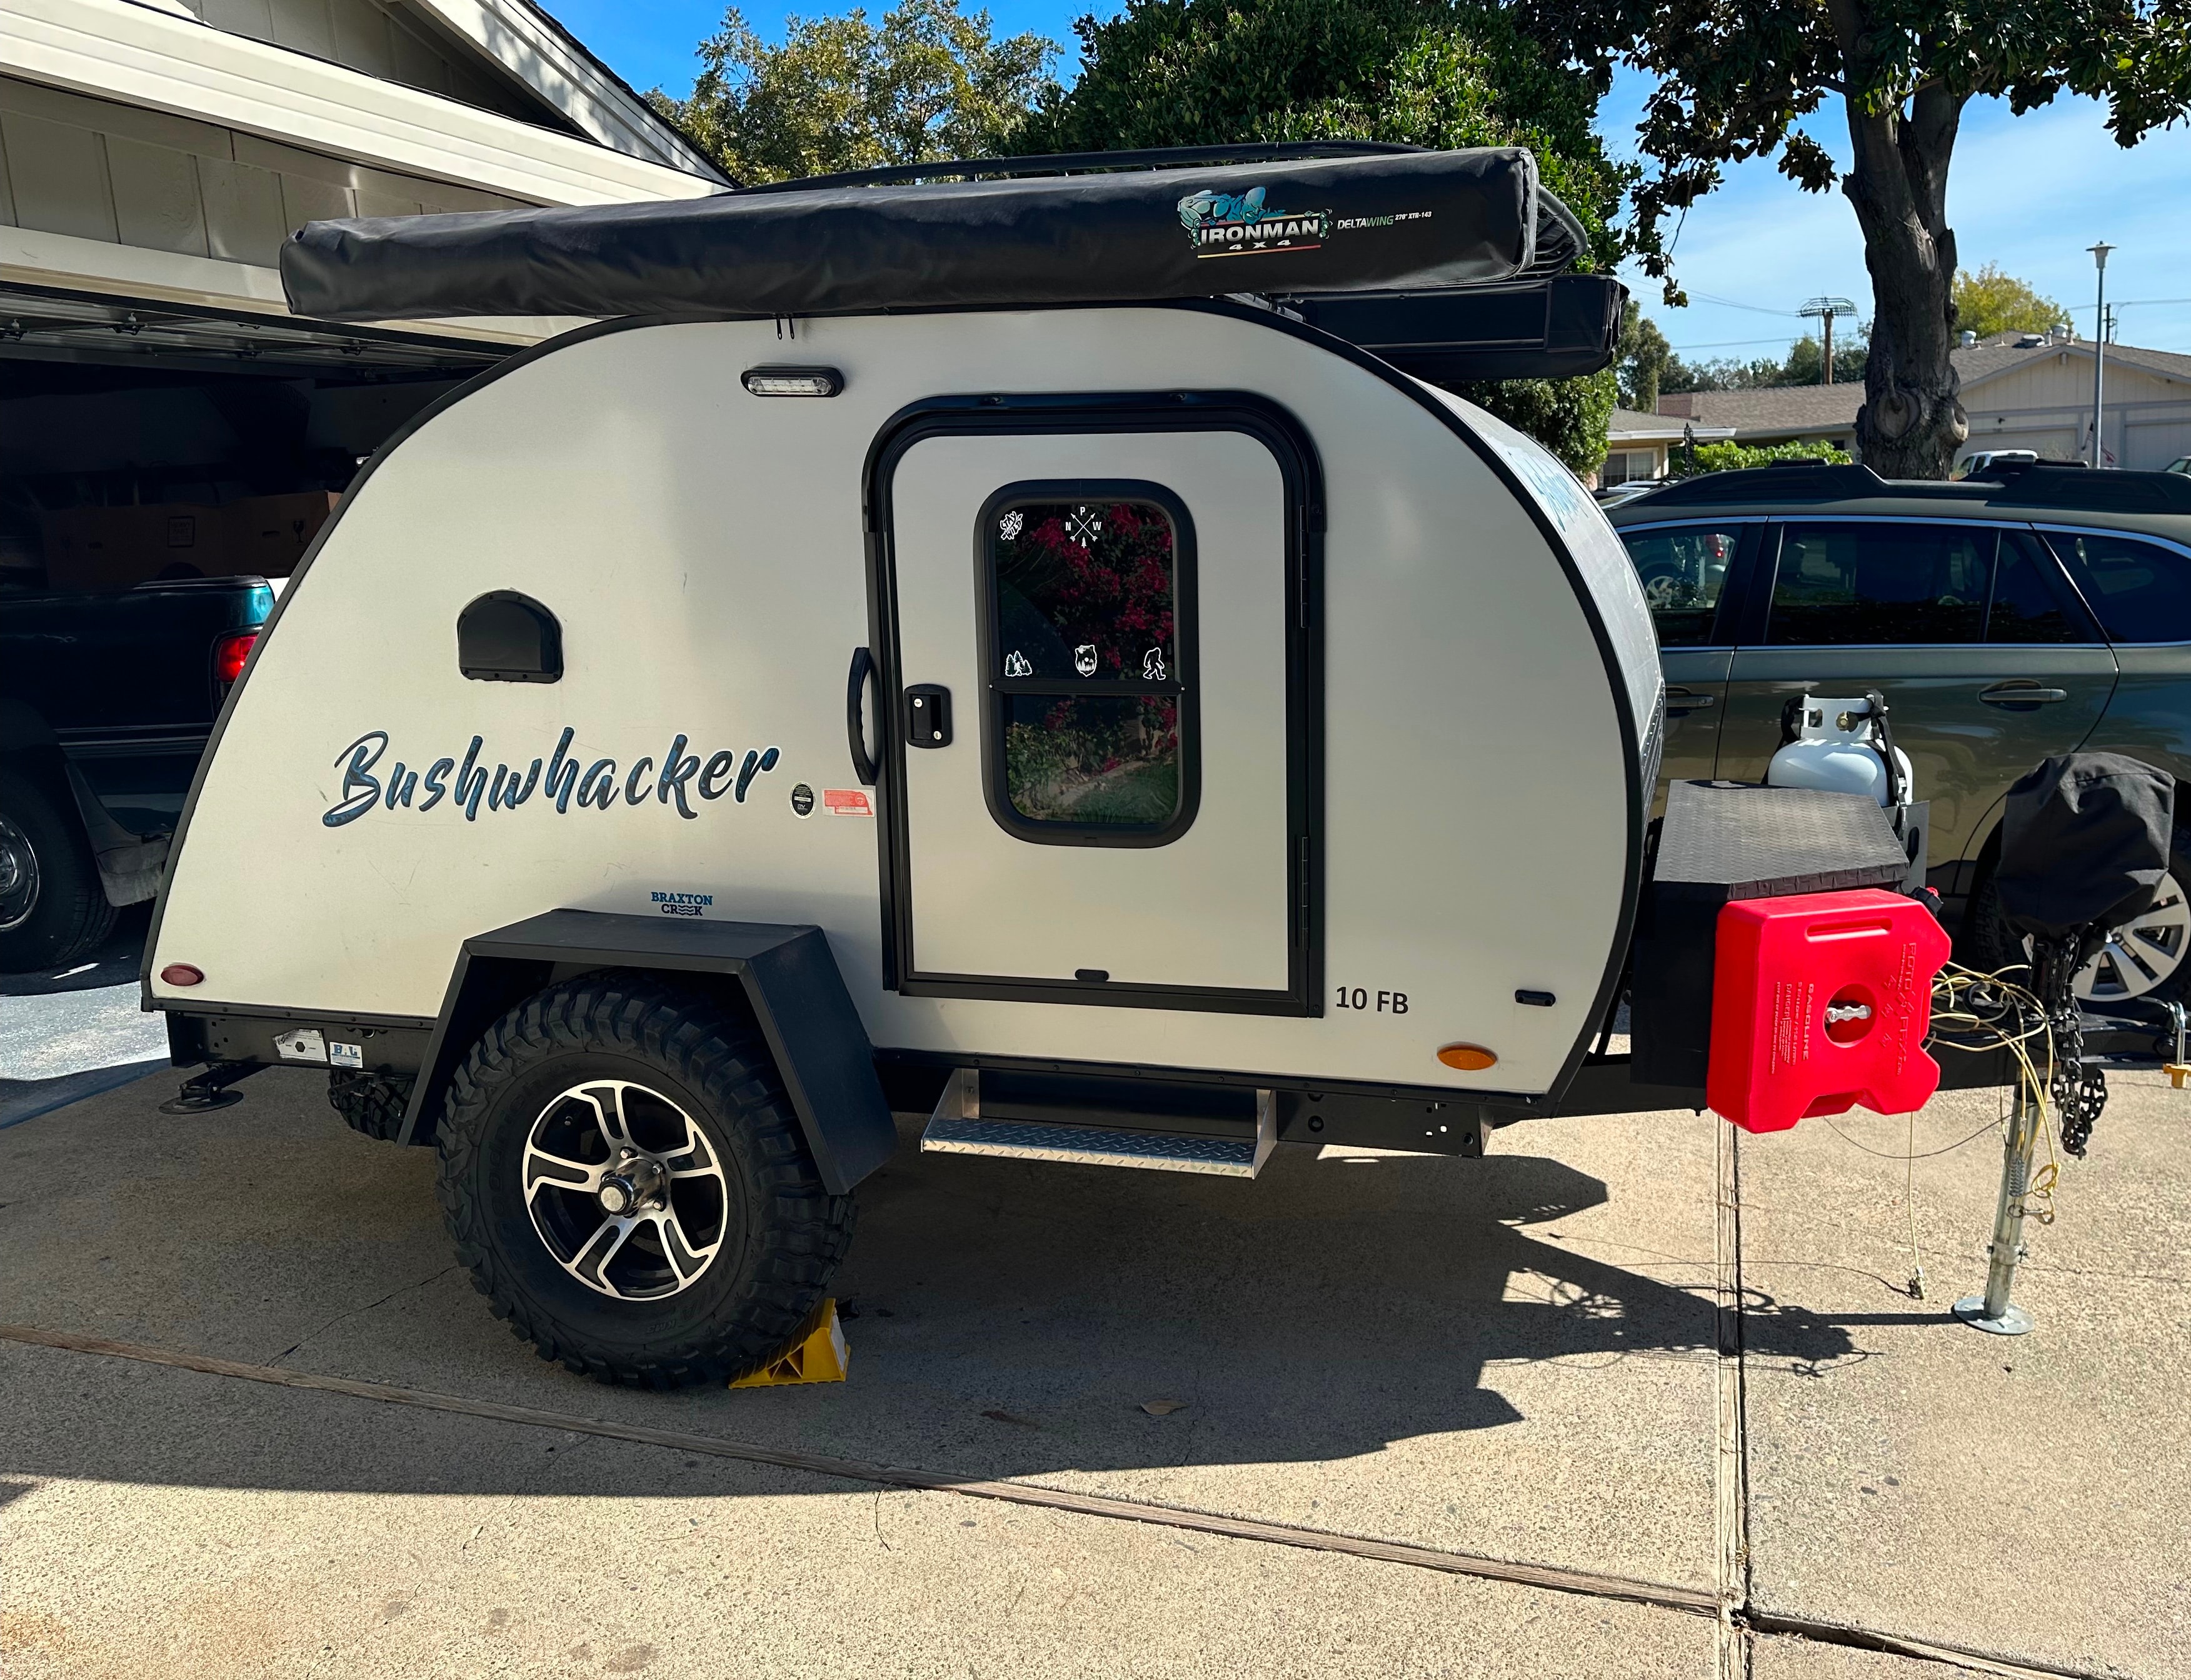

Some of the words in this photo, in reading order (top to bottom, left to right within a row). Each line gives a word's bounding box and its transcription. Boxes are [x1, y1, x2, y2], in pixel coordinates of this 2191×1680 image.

[1336, 215, 1395, 230] DELTAWING
[1200, 219, 1319, 244] IRONMAN
[1080, 506, 1086, 516] P
[1065, 521, 1071, 531] N
[1092, 521, 1102, 531] W
[322, 726, 781, 828] Bushwhacker
[651, 891, 713, 906] BRAXTON
[1336, 986, 1368, 1010] 10
[1376, 990, 1409, 1014] FB
[1803, 982, 1815, 1061] GASOLINE
